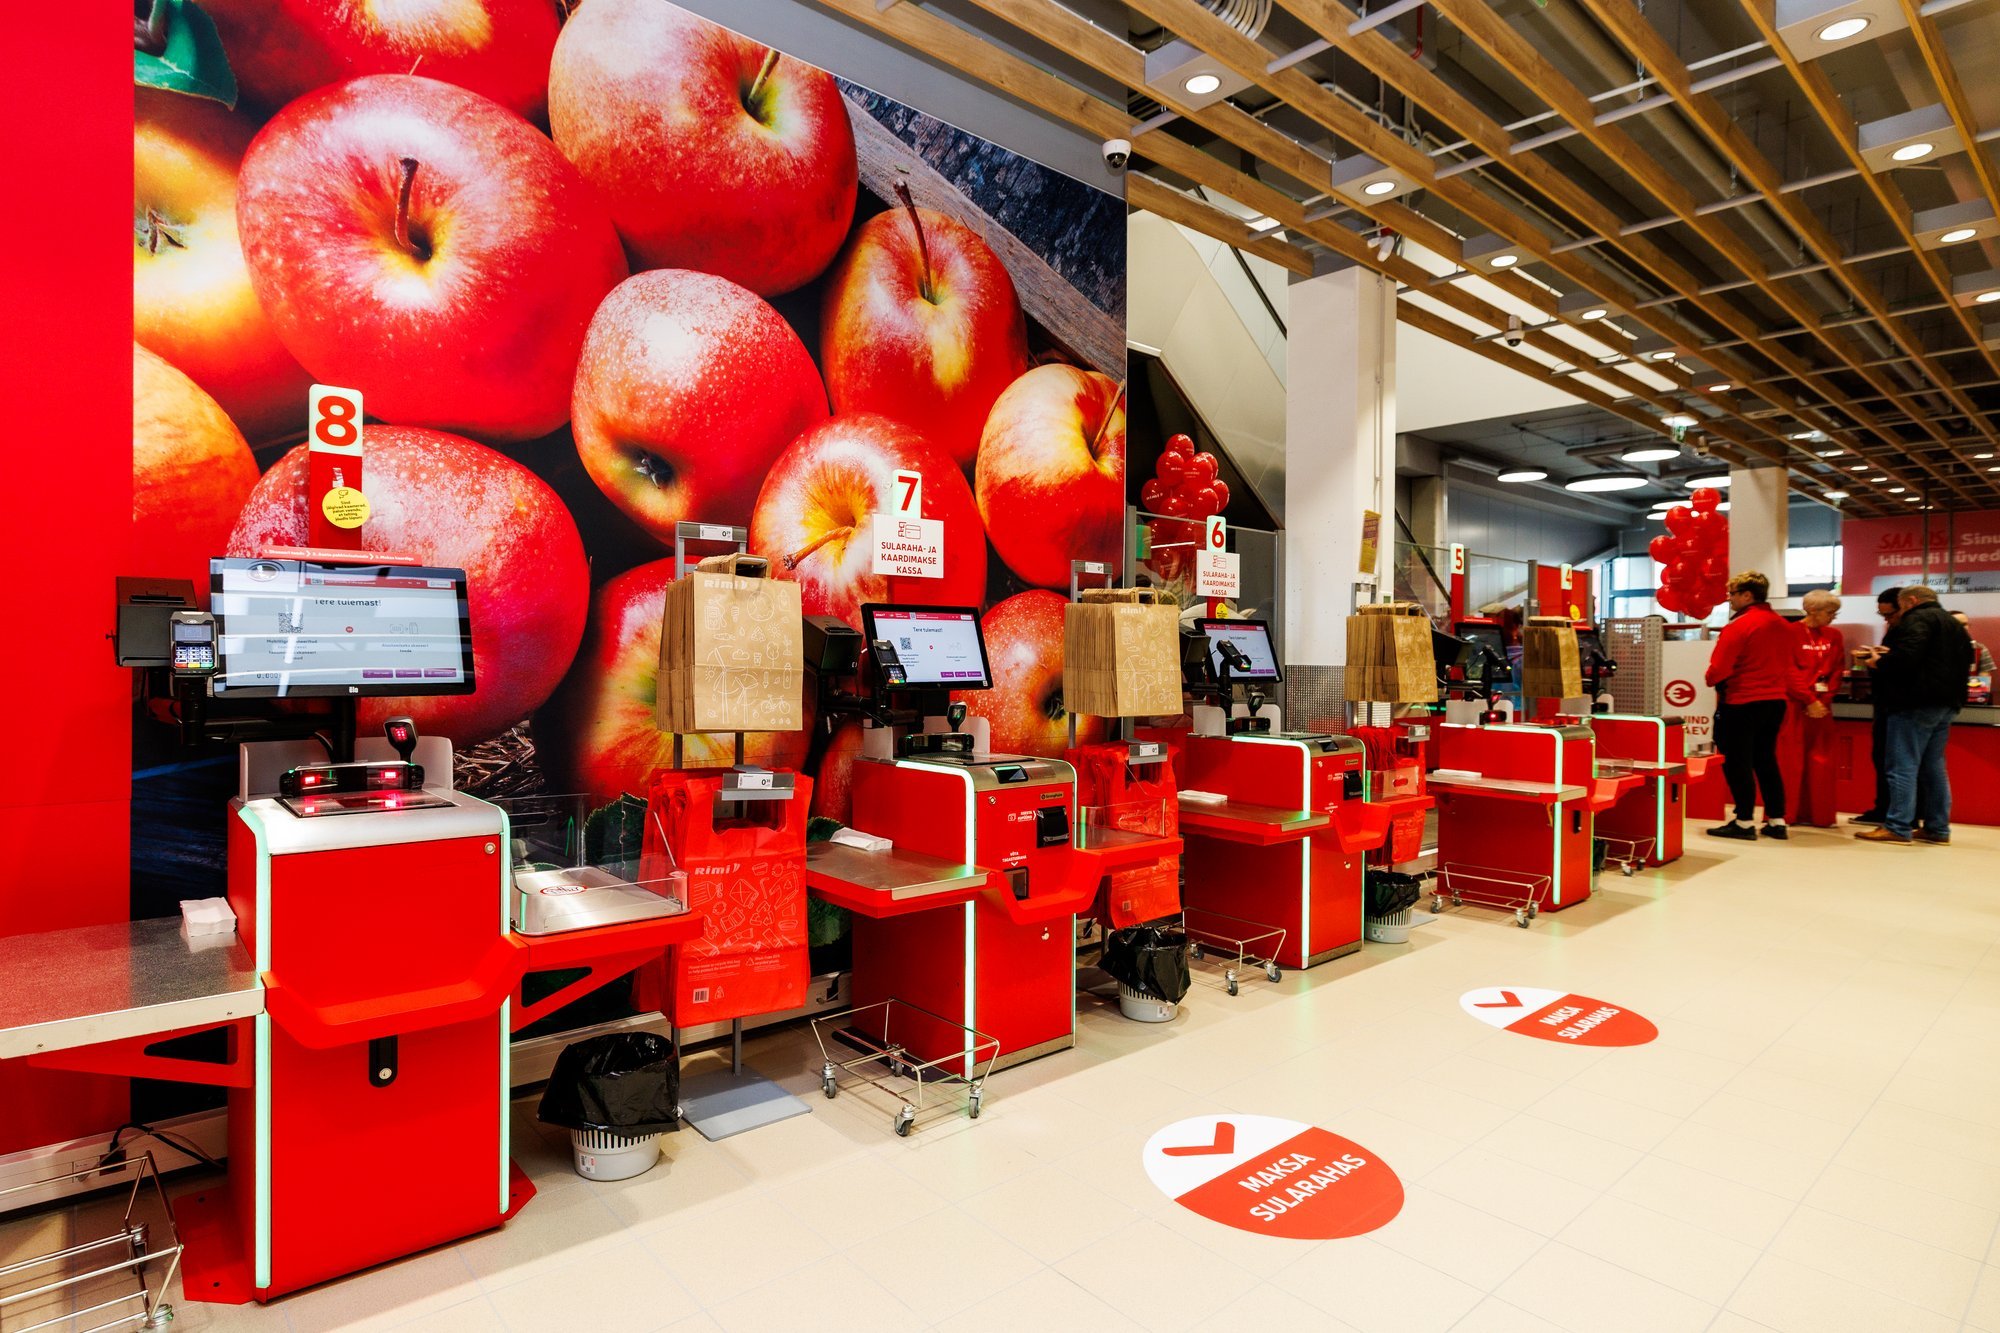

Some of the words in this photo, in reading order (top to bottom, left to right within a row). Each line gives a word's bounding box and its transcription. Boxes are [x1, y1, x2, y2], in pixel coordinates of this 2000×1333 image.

[316, 396, 358, 446] 8
[898, 476, 918, 511] 7
[1212, 522, 1224, 548] 6
[882, 542, 926, 552] SULARAHA-
[881, 553, 937, 564] KAARDIMAKSE
[1456, 548, 1462, 570] 5
[896, 566, 922, 574] KASSA
[1203, 570, 1229, 579] SULARAHA-
[1566, 569, 1572, 586] 4
[694, 864, 731, 875] Rimi
[1539, 1006, 1584, 1026] MAKSA
[1557, 1006, 1620, 1040] SULARAHAS
[1238, 1152, 1316, 1192] MAKSA
[1250, 1153, 1366, 1222] SULARAHAS
